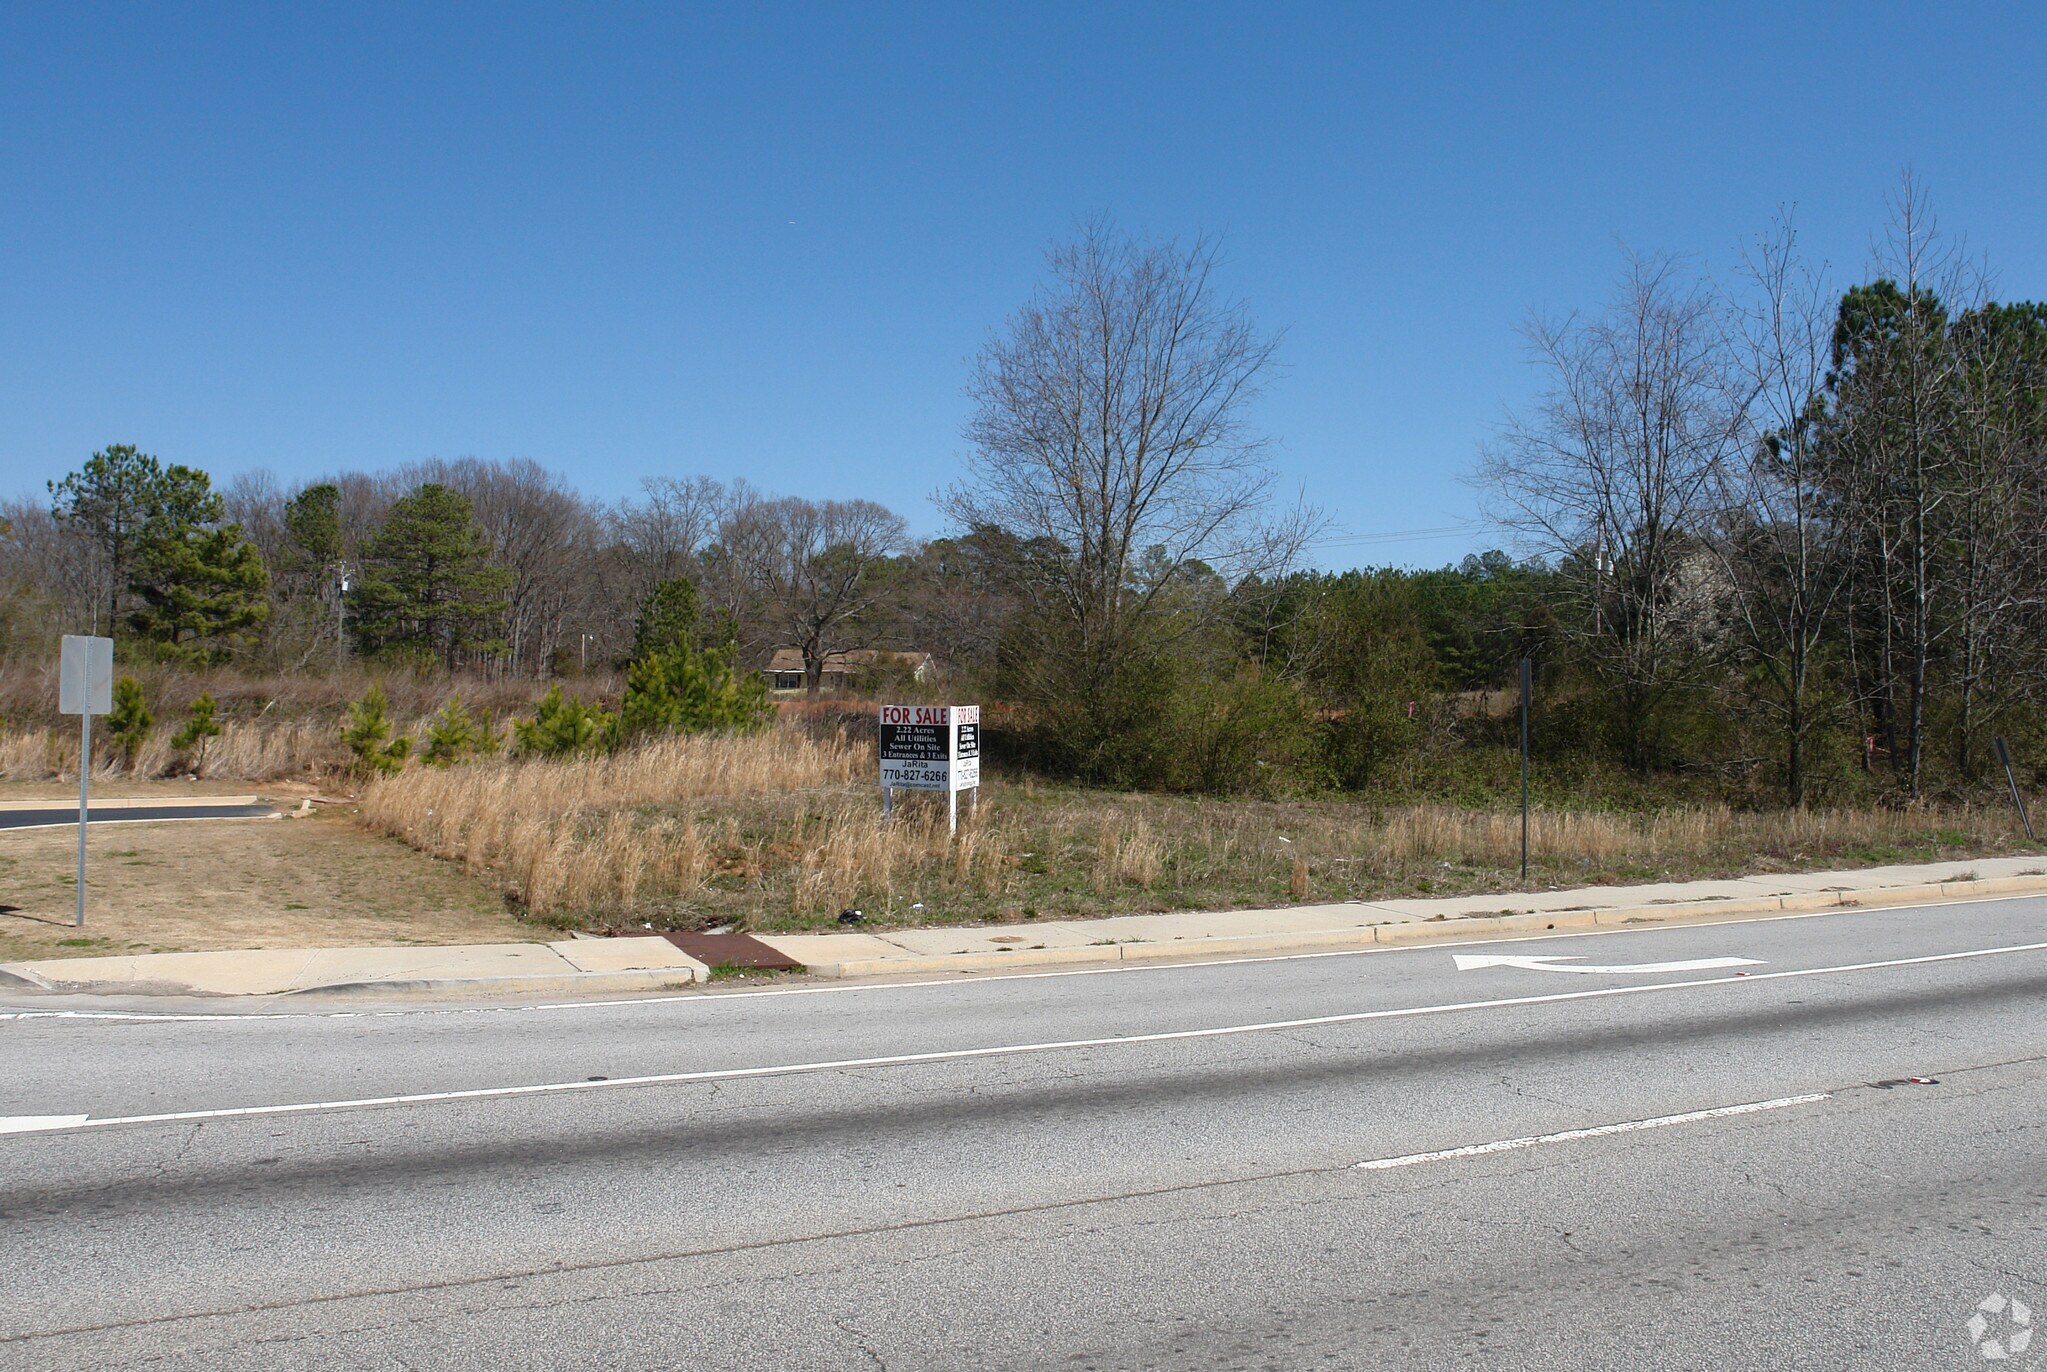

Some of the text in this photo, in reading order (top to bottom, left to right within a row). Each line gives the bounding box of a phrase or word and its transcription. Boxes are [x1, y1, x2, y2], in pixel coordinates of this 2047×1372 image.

[883, 707, 947, 724] FOR SALE
[902, 760, 928, 768] JaRita
[883, 769, 947, 781] 770-827-6266
